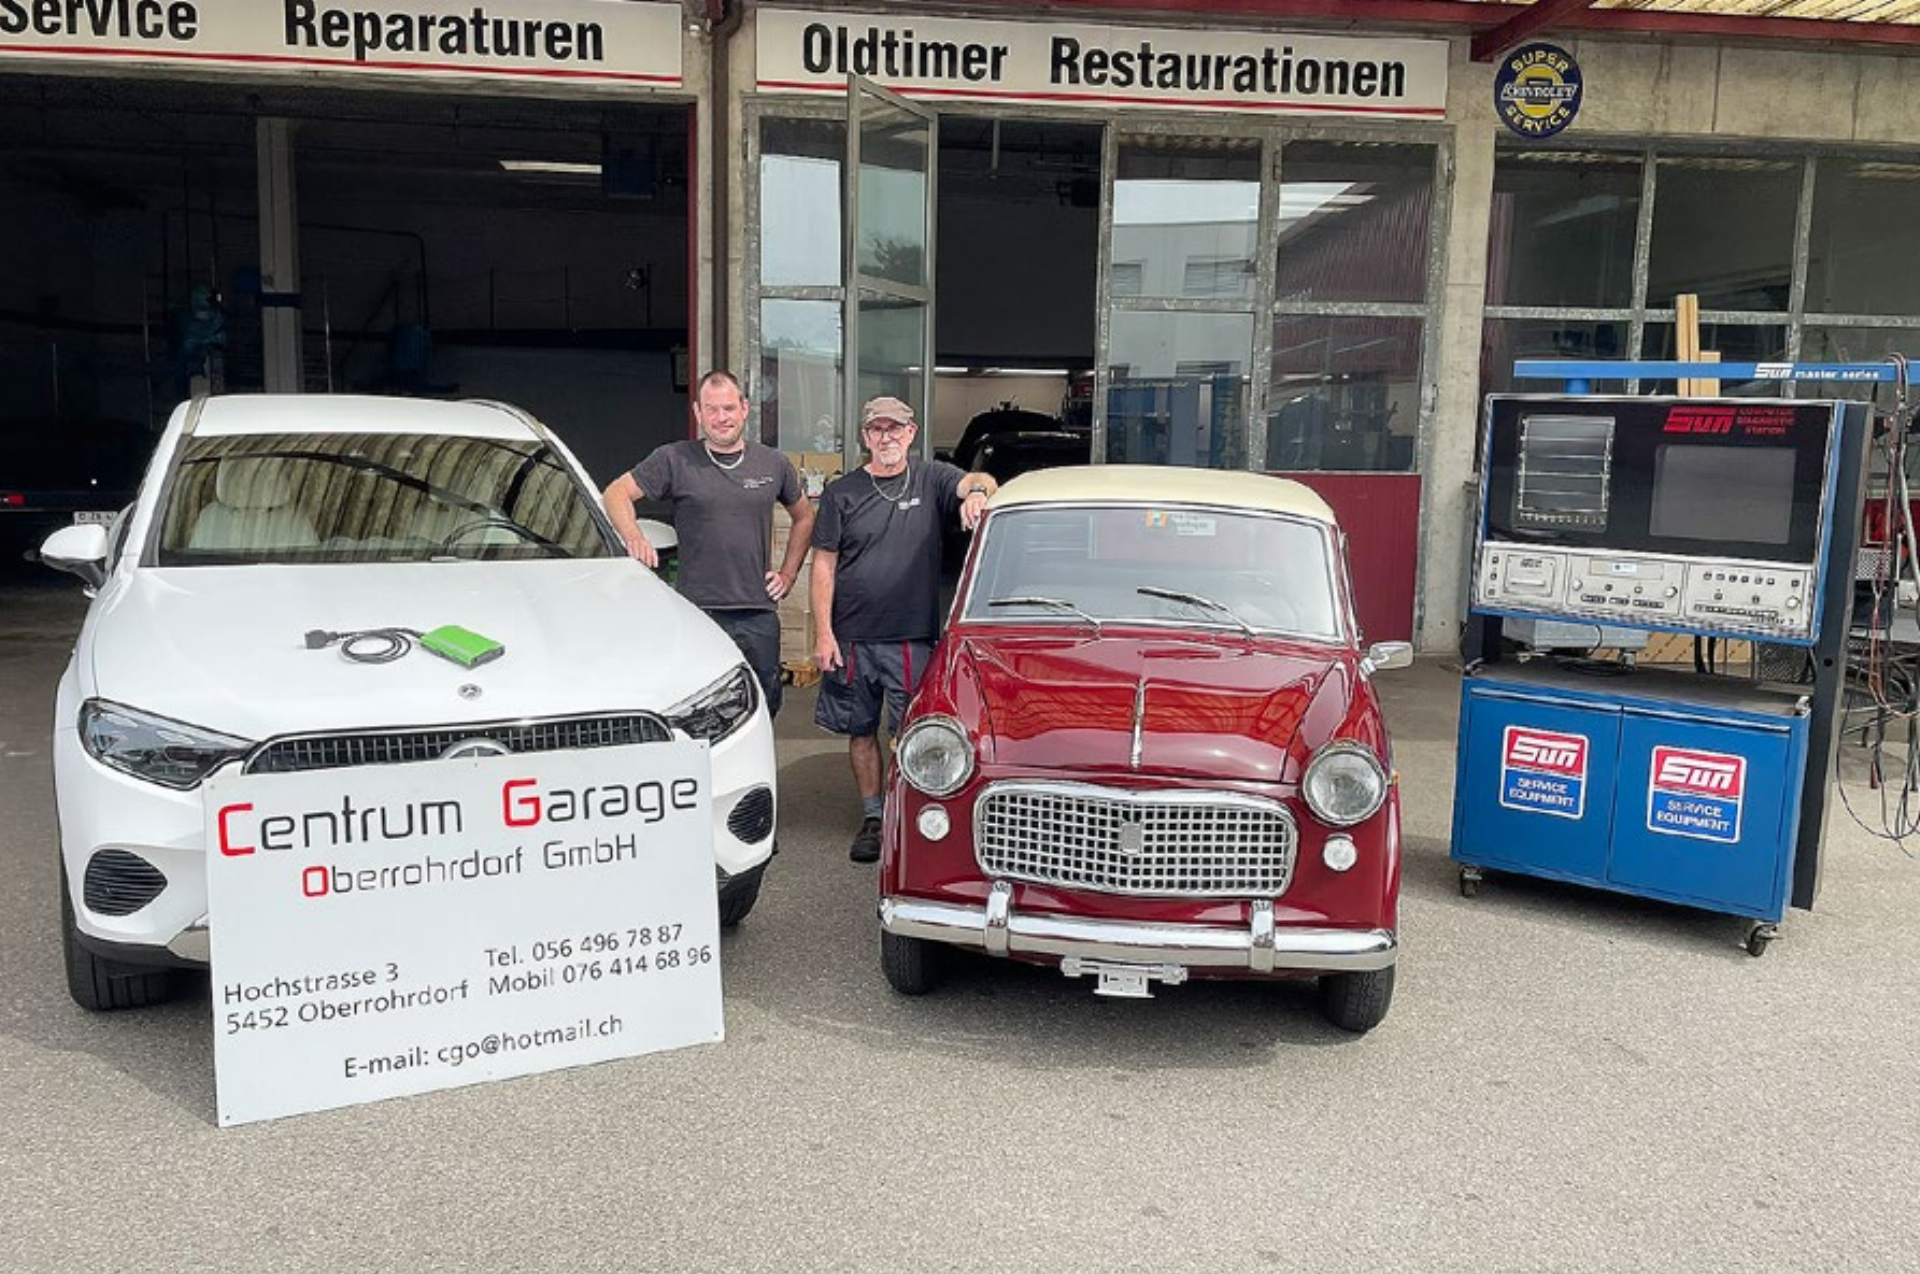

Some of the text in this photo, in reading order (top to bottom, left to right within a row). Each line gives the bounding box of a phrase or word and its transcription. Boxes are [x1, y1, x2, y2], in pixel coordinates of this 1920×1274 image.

[0, 0, 604, 61] Service Reparaturen
[803, 22, 1406, 97] Oldtimer Restaurationen
[1511, 50, 1569, 73] SUPER
[1505, 86, 1574, 98] CHEVROLET
[1505, 104, 1571, 132] SERVICE
[1795, 369, 1838, 379] master
[1842, 369, 1879, 379] series
[1509, 788, 1575, 807] EQUIPMENT
[1518, 778, 1568, 794] SERVICE
[218, 778, 698, 856] Centrum Garage
[1657, 811, 1731, 832] EQUIPMENT
[1668, 800, 1723, 817] SERVICE
[302, 833, 637, 897] Oberrohrdorf GmbH
[484, 923, 683, 967] Tel. 056 496 78 87
[224, 962, 399, 1005] Hochstrasse 3
[488, 944, 712, 996] Mobil 076 414 68 96
[226, 979, 469, 1035] 5452 Oberrohrdorf
[344, 1014, 623, 1078] E-mail: cgo@hotmail.ch
